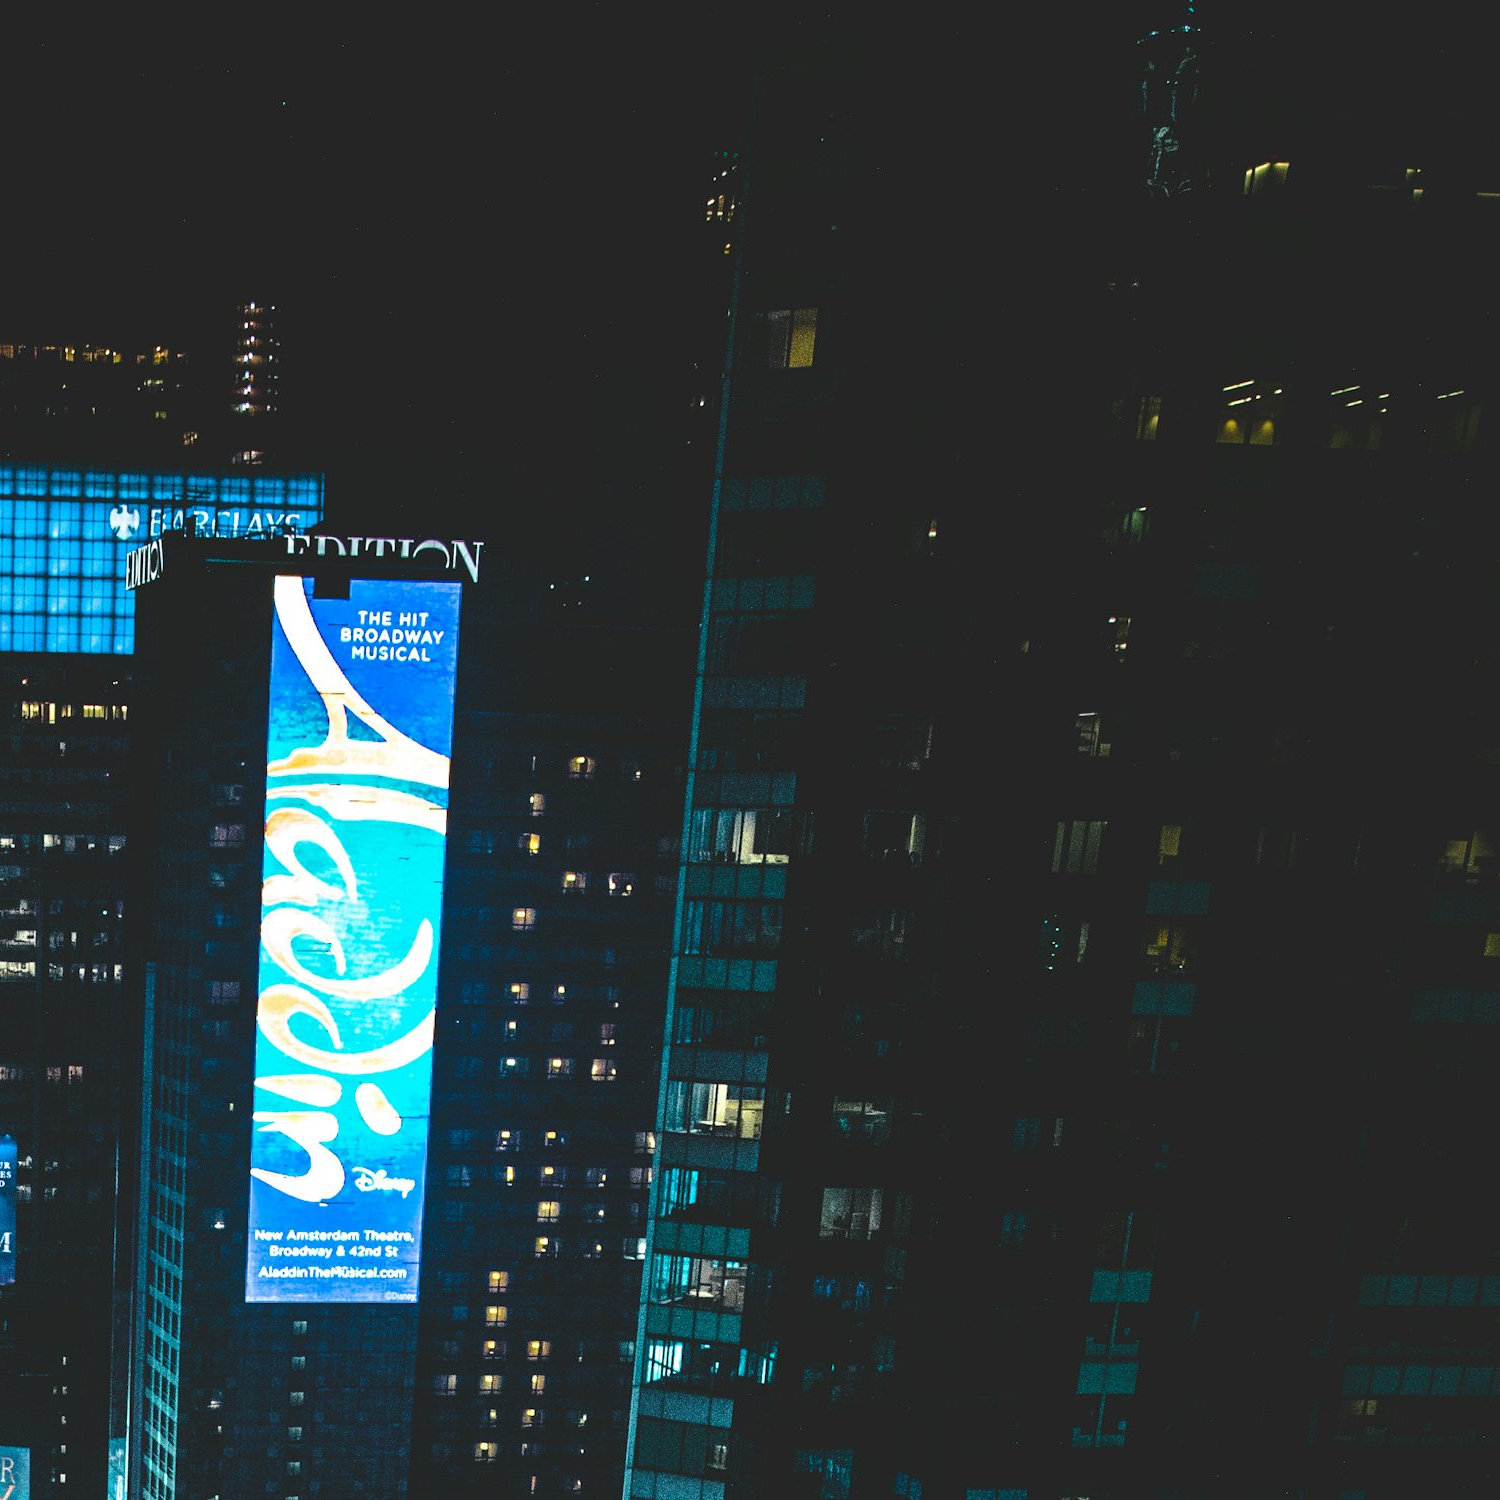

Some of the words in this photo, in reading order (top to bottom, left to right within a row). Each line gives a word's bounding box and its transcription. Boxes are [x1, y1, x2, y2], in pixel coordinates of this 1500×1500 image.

[150, 509, 300, 539] BARCLAYS
[358, 611, 392, 626] THE
[399, 612, 429, 627] HIT
[340, 628, 445, 646] BROADWAY
[351, 646, 431, 662] MUSICAL
[352, 1167, 416, 1199] Disney
[254, 1229, 283, 1241] New
[287, 1229, 360, 1241] Amsterdam
[363, 1229, 414, 1242] Theatre,
[269, 1245, 333, 1258] Broadway
[336, 1245, 346, 1257] &
[349, 1245, 381, 1257] 42nd
[384, 1246, 398, 1257] St
[258, 1266, 407, 1279] AladdinTheMusical.com
